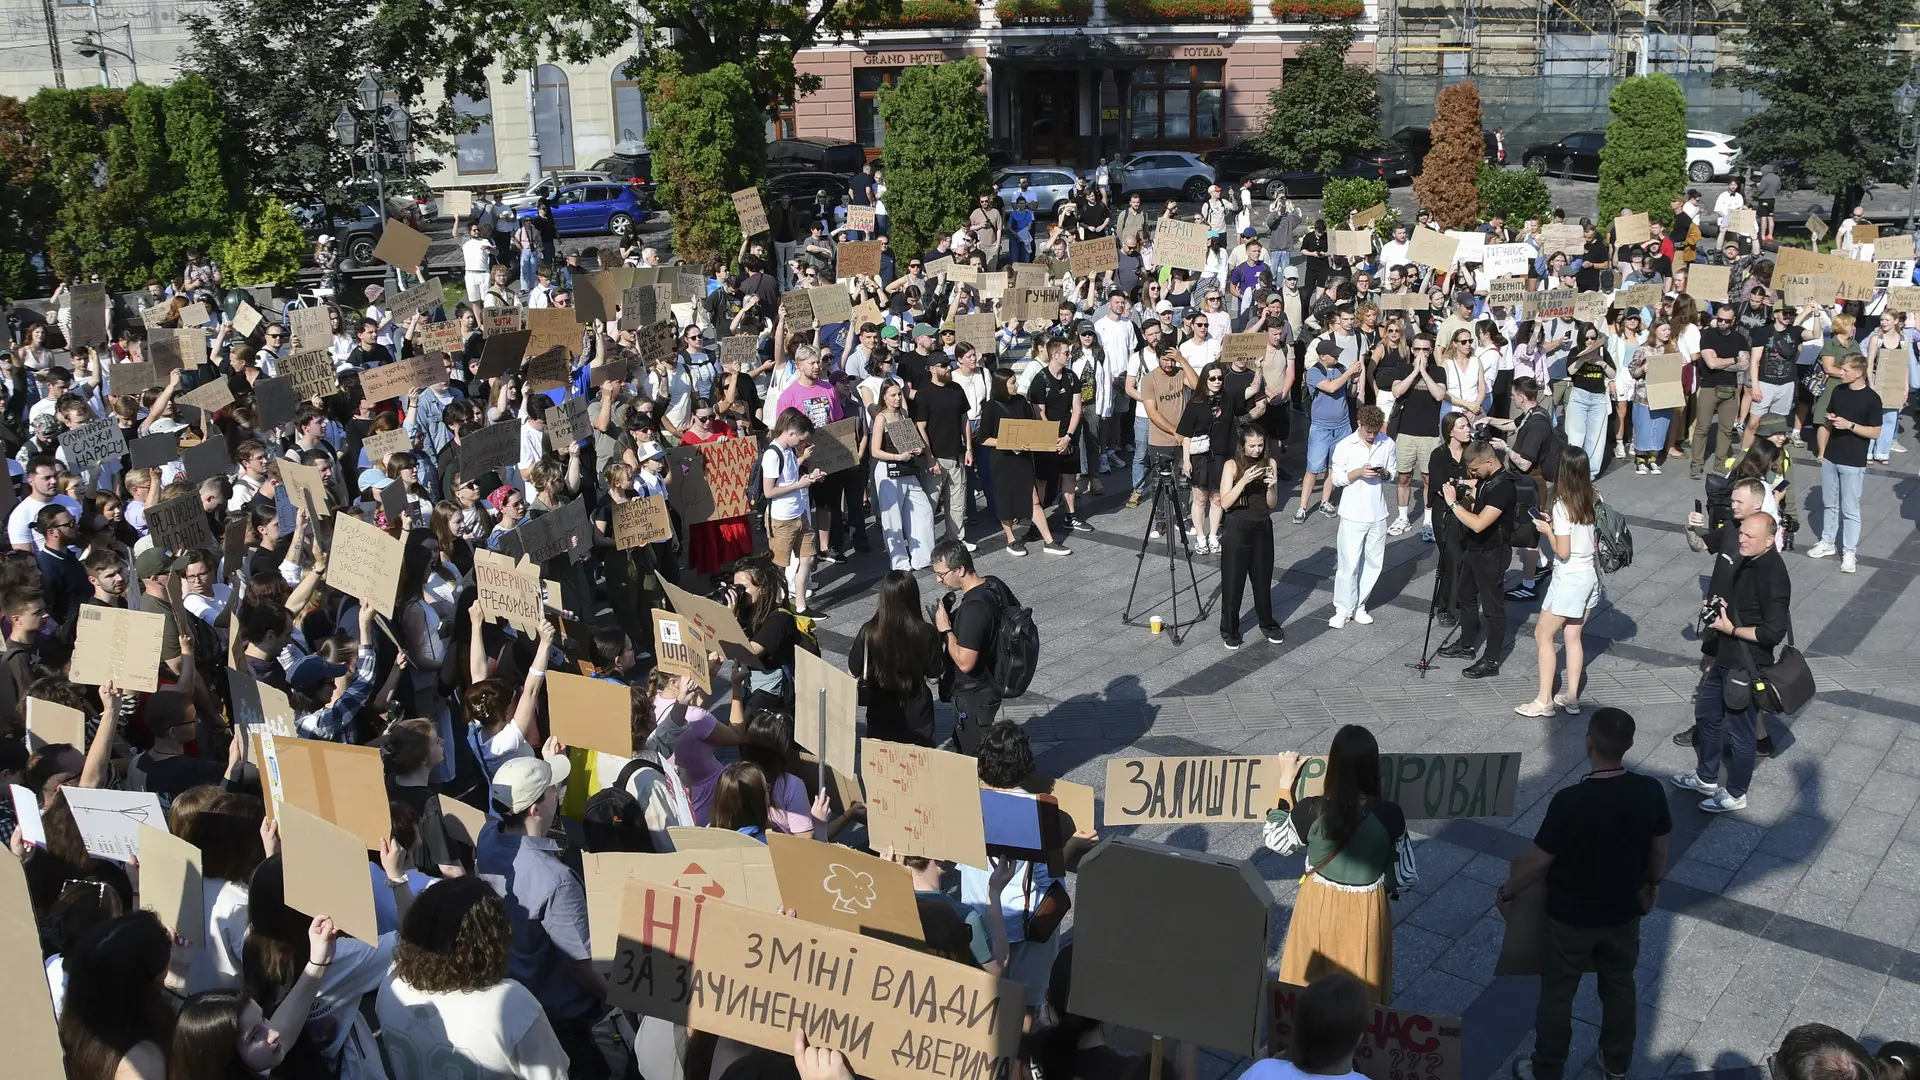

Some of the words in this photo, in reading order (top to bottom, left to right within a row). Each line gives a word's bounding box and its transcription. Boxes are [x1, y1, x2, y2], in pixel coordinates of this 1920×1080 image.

[864, 53, 905, 64] GRAND
[910, 53, 946, 63] HOTEL
[1183, 47, 1223, 57] ГОТЕЛЬ
[1490, 281, 1525, 292] ПОВЕРНІТЬ
[1527, 289, 1573, 302] НАСТУПНЕ
[1491, 292, 1524, 303] ФЕДОРОВА
[1539, 306, 1575, 317] НАРОДОМ
[493, 317, 512, 327] ЧУТИ
[277, 360, 291, 375] НЕ
[291, 350, 327, 372] ЧІПАЙТЕ
[72, 429, 114, 454] СЛУЖИ
[75, 439, 124, 469] НАРОДУ
[619, 496, 651, 513] УКРАЇНУ
[151, 495, 202, 535] ФЕДОРОВА
[620, 505, 660, 523] ВБИВАЮТЬ
[642, 522, 653, 531] ТА
[619, 533, 636, 547] ТУПІ
[637, 527, 666, 540] РІШЕННЯ
[477, 565, 534, 594] ПОВЕРНІТЬ
[1121, 758, 1262, 820] ЗАЛИШТЕ
[642, 888, 707, 965] НІ
[744, 933, 859, 996] ЗМІНІ
[871, 965, 1000, 1036] ВЛАДИ
[617, 949, 655, 997] ЗА
[670, 965, 876, 1061] ЗАЧИНЕНИМИ
